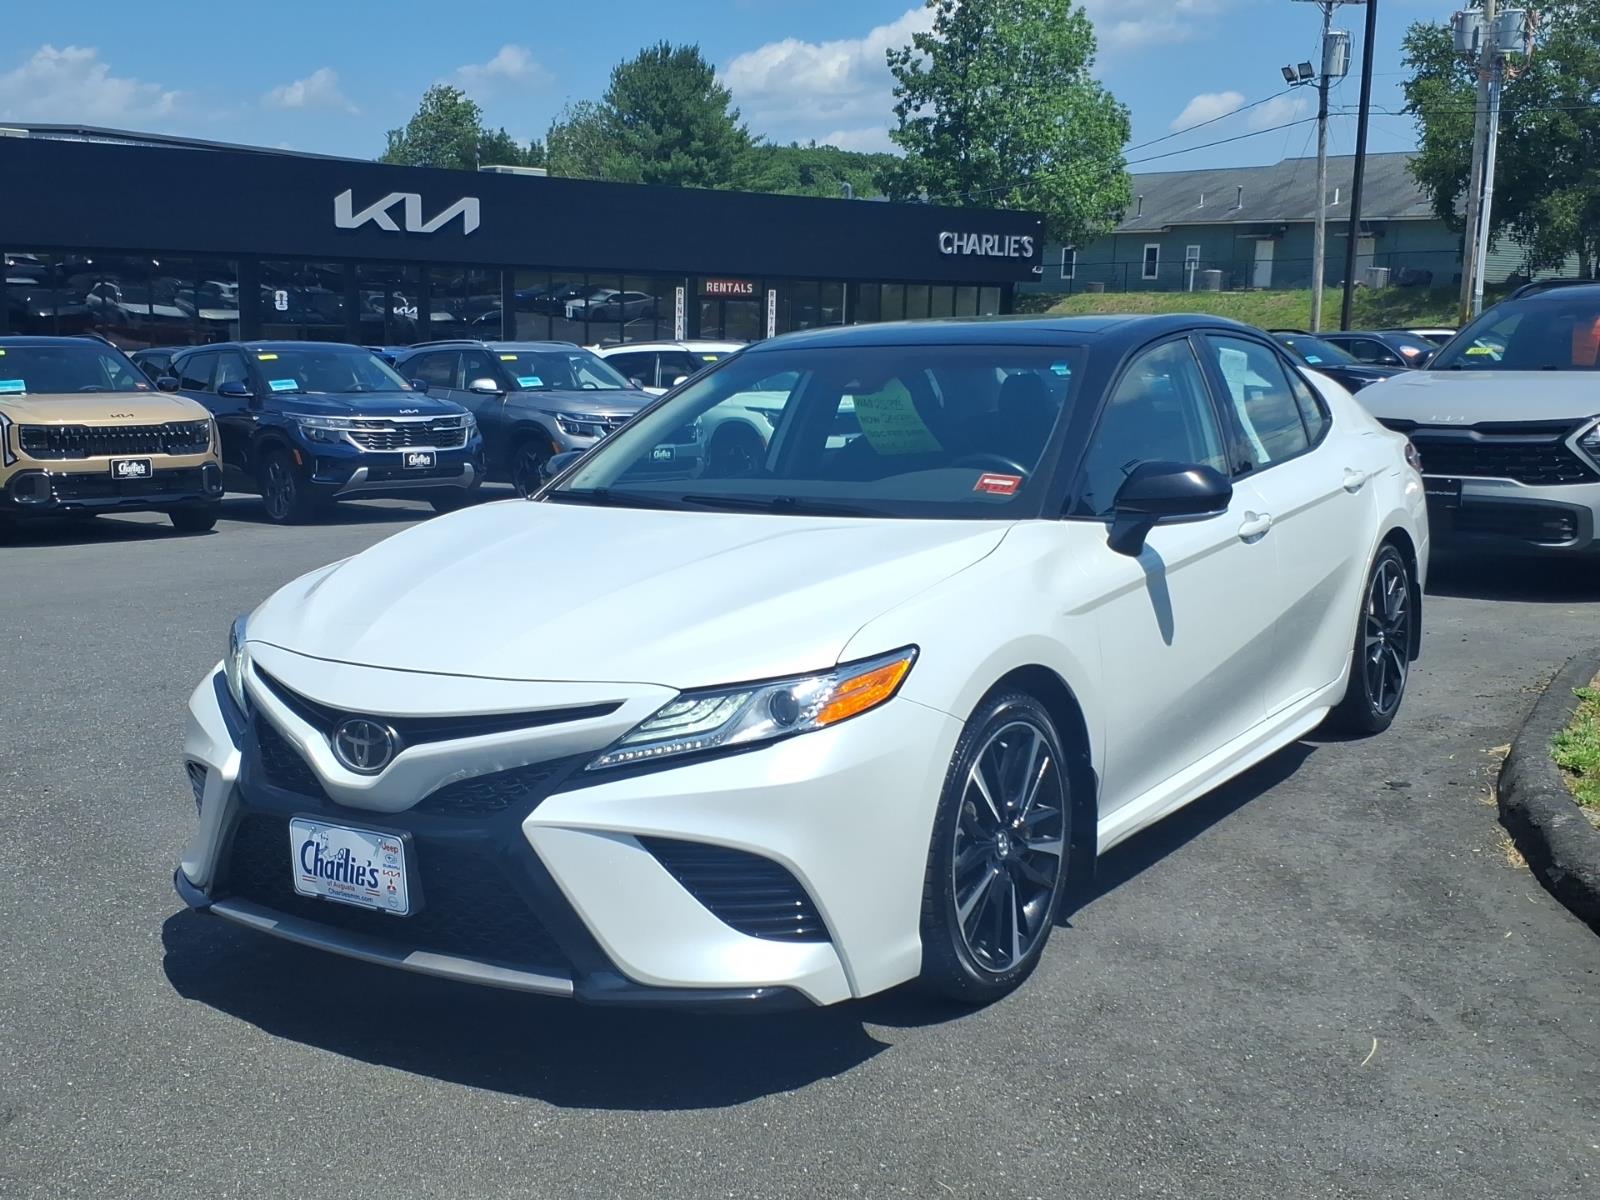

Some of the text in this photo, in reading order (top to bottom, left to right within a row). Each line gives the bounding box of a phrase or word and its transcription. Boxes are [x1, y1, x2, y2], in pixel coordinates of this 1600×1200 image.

[334, 188, 480, 236] KIA
[938, 231, 1034, 258] CHARLIE'S
[706, 281, 753, 294] RENTALS
[118, 461, 146, 474] Charlie's
[382, 842, 399, 855] Jeep
[300, 840, 379, 889] Charlie's
[383, 869, 400, 878] KIA
